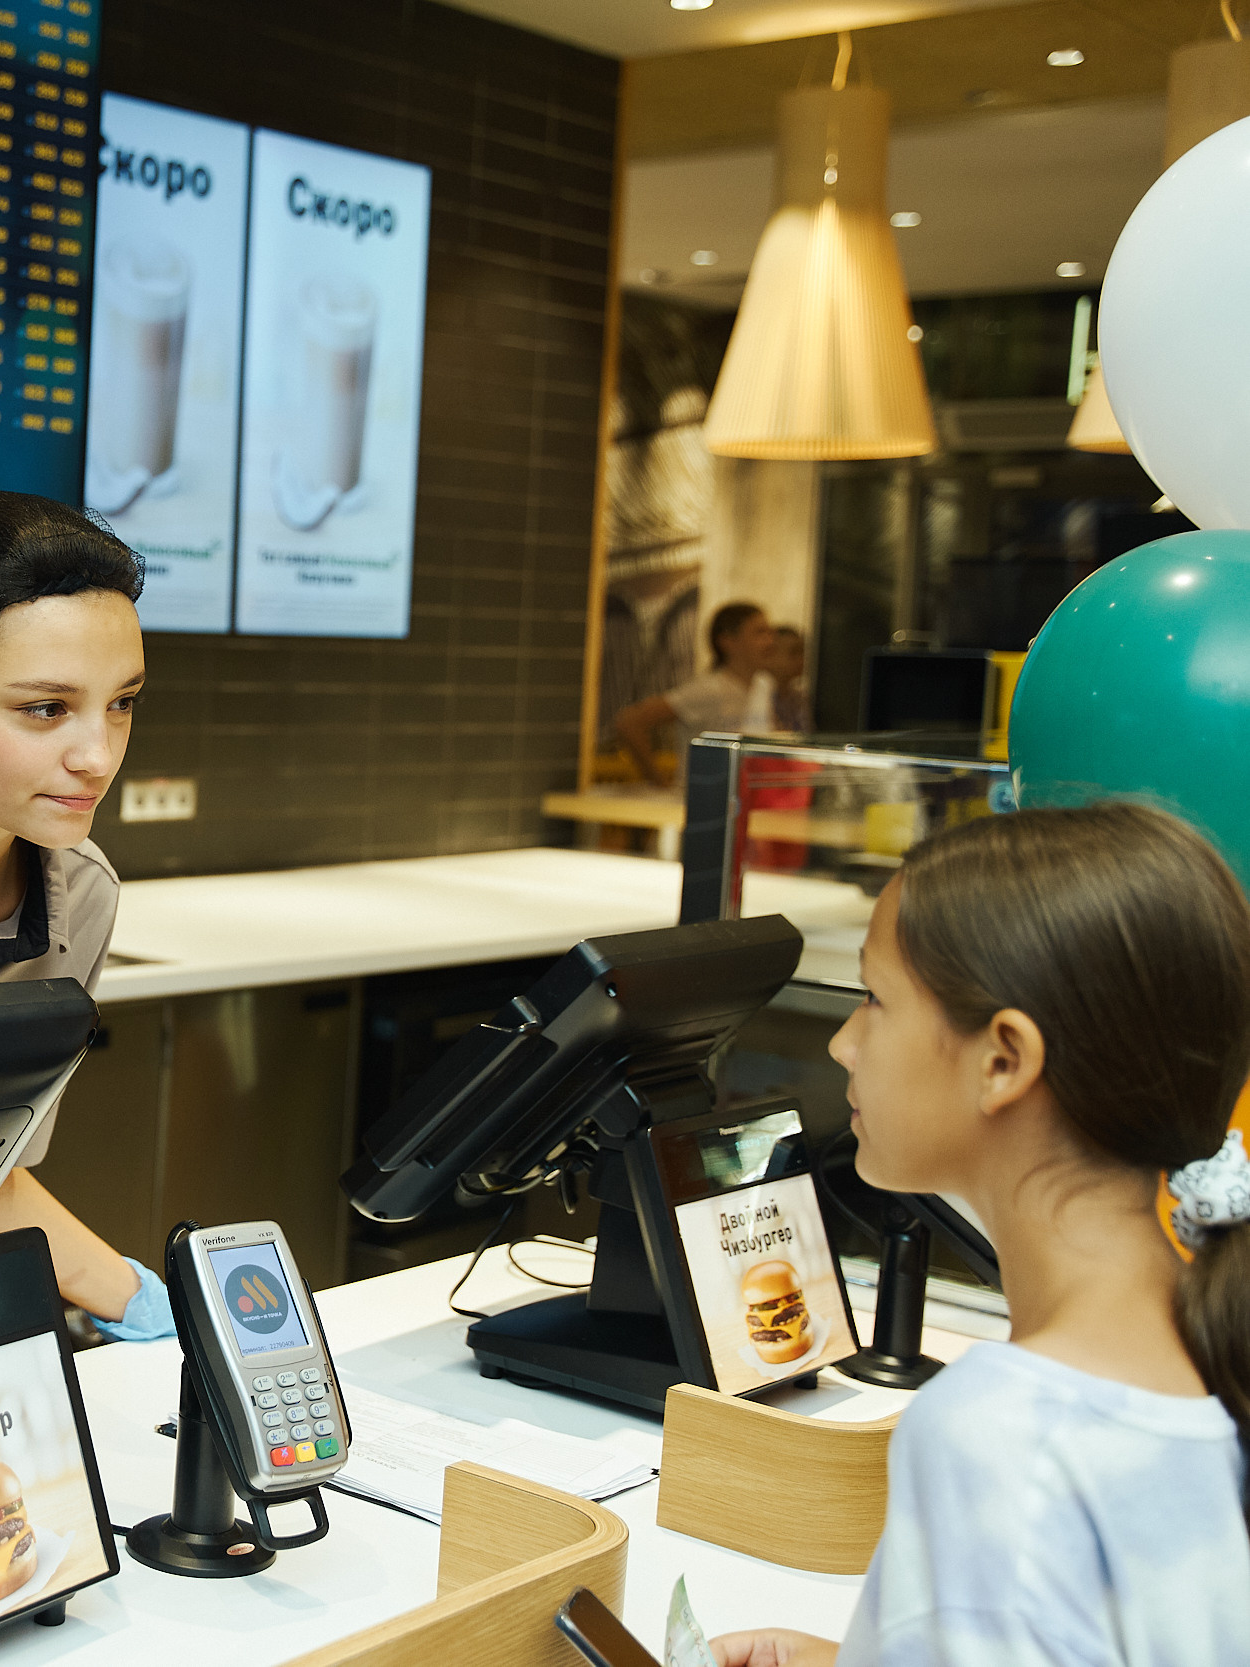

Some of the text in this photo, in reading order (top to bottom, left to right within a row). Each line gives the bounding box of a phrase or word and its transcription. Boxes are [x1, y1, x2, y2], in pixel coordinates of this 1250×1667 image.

[287, 175, 398, 241] Скоро
[202, 1235, 236, 1246] Verifone
[720, 1226, 793, 1257] Чизбургер
